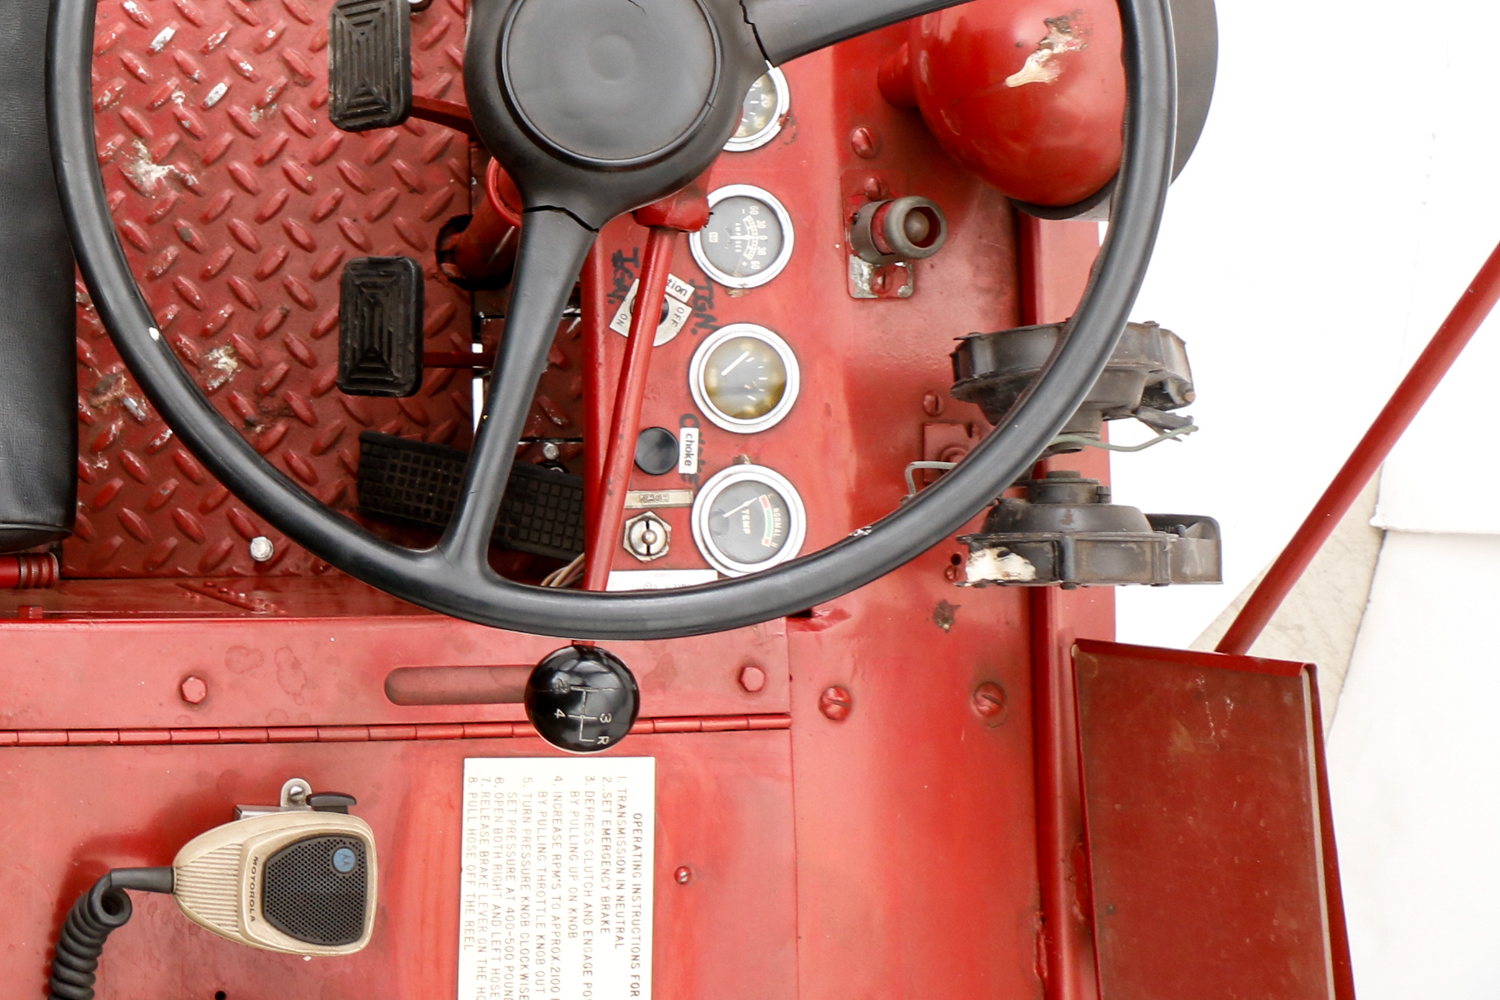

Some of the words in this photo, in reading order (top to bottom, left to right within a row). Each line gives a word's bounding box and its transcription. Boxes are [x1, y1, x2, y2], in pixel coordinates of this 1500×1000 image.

[760, 94, 771, 107] 20
[749, 206, 759, 215] 60
[756, 220, 766, 228] 30
[750, 260, 760, 270] 60
[756, 246, 766, 255] 30
[616, 313, 627, 327] ON
[671, 306, 684, 326] OFF
[684, 433, 694, 467] choke
[741, 508, 751, 534] TEMP
[772, 508, 782, 537] NORMAL
[554, 708, 565, 718] 4
[599, 713, 611, 723] 3
[597, 736, 609, 744] R
[467, 793, 478, 822] PULL
[494, 793, 504, 822] OPEN
[507, 792, 517, 813] SET
[522, 793, 532, 823] TURN
[538, 791, 548, 804] BY
[570, 791, 580, 804] BY
[480, 792, 490, 844] RELEASE
[552, 792, 562, 847] INCREASE
[584, 791, 595, 844] DEPRESS
[616, 789, 627, 874] TRANSMISSION
[467, 829, 476, 858] HOSE
[493, 828, 503, 858] BOTH
[537, 811, 547, 861] PULLING
[569, 811, 579, 860] PULLING
[632, 813, 642, 878] OPERATING
[506, 820, 516, 881] PRESSURE
[521, 829, 531, 890] PRESSURE
[601, 820, 611, 890] EMERGENCY
[466, 865, 476, 886] OFF
[479, 851, 489, 887] BRAKE
[493, 864, 502, 897] RIGHT
[552, 854, 561, 889] RPM'S
[569, 867, 578, 880] UP
[584, 850, 593, 896] CLUTCH
[249, 856, 259, 922] MOTOROLA
[506, 887, 515, 900] AT
[536, 867, 546, 928] THROTTLE
[568, 887, 578, 901] ON
[616, 880, 625, 889] IN
[465, 893, 475, 914] THE
[478, 895, 488, 931] LEVER
[491, 904, 501, 926] AND
[520, 896, 530, 926] KNOB
[551, 895, 561, 909] TO
[583, 903, 593, 925] AND
[600, 896, 610, 933] BRAKE
[464, 921, 474, 950] REEL
[504, 907, 515, 960] 400-500
[568, 908, 578, 938] KNOB
[615, 895, 625, 949] NEUTRAL
[631, 884, 641, 969] INSTRUCTIONS
[477, 938, 487, 952] ON
[491, 932, 501, 961] LEFT
[536, 935, 545, 965] KNOB
[583, 930, 593, 976] ENGAGE
[477, 959, 487, 980] THE
[490, 968, 500, 998] HOSE
[535, 971, 545, 993] OUT
[582, 983, 592, 1000] PO
[630, 974, 640, 997] FOR
